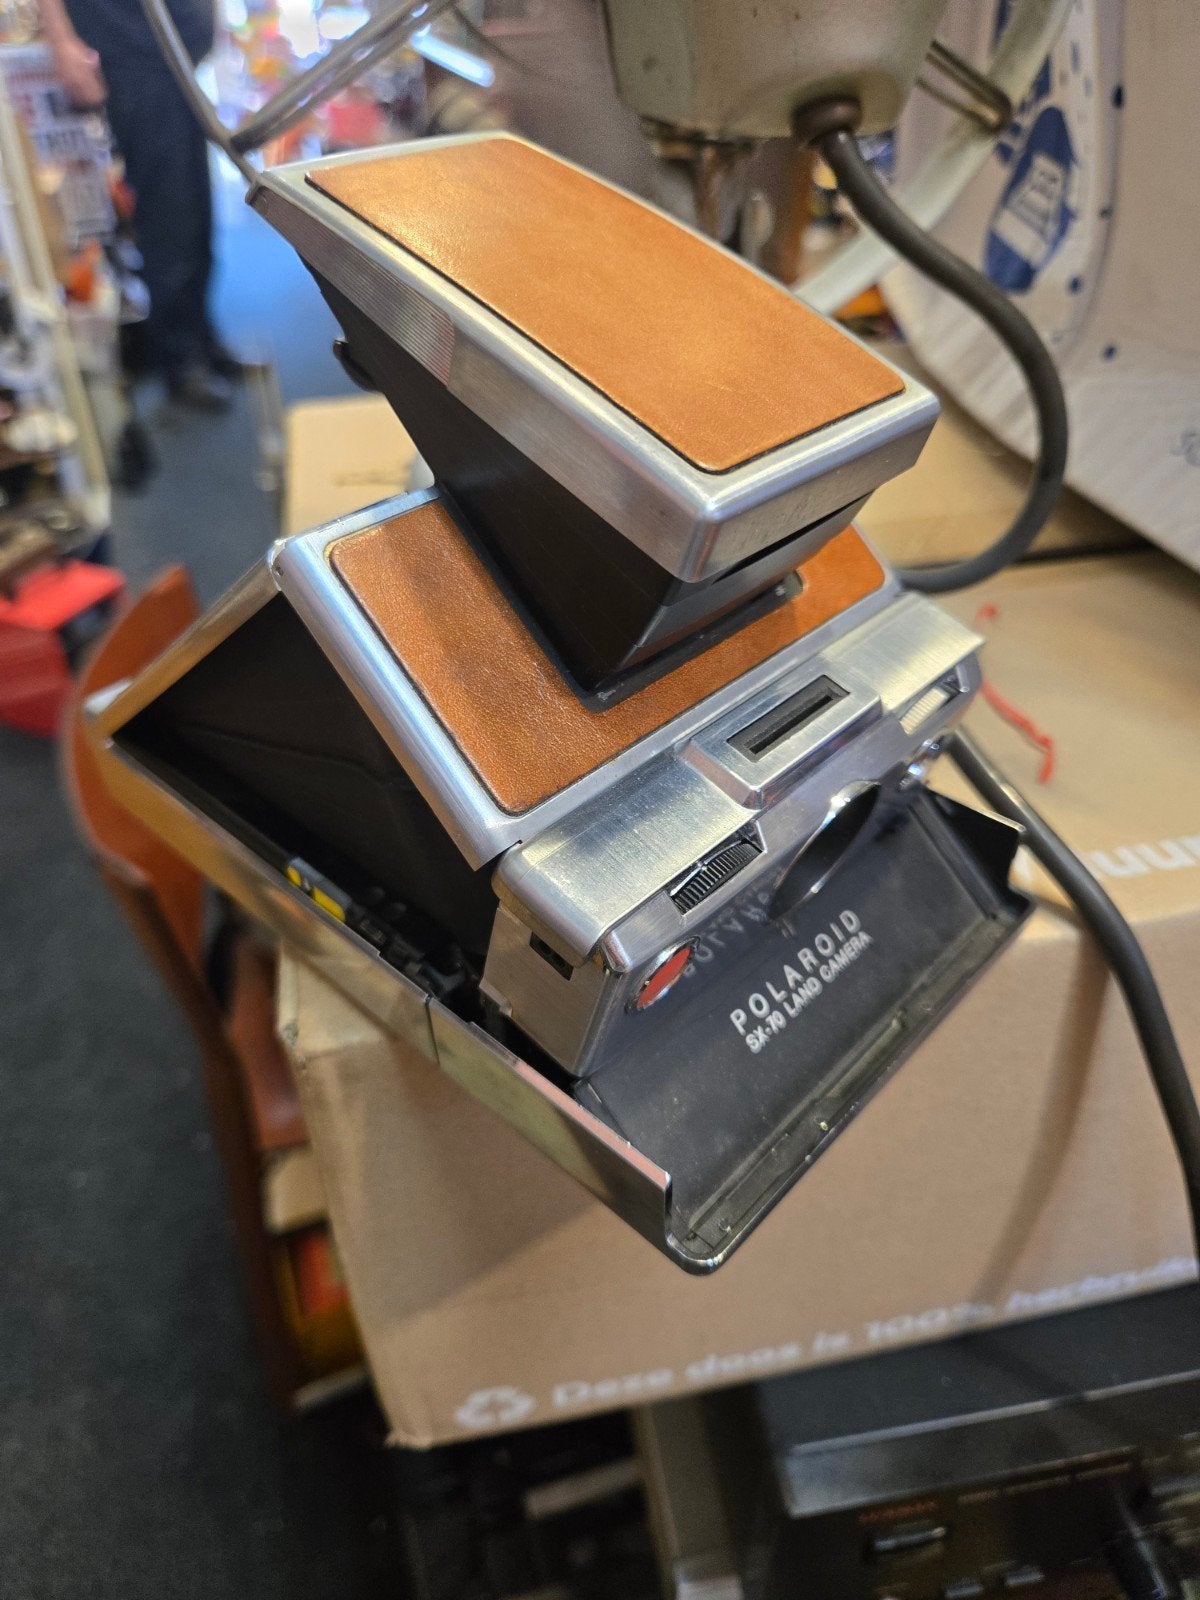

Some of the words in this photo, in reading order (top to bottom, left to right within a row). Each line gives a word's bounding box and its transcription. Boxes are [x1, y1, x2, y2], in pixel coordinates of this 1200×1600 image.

[730, 910, 861, 1036] POLAROID
[745, 1010, 786, 1053] SX-70
[783, 976, 823, 1018] LAND
[819, 931, 873, 983] CAMERA
